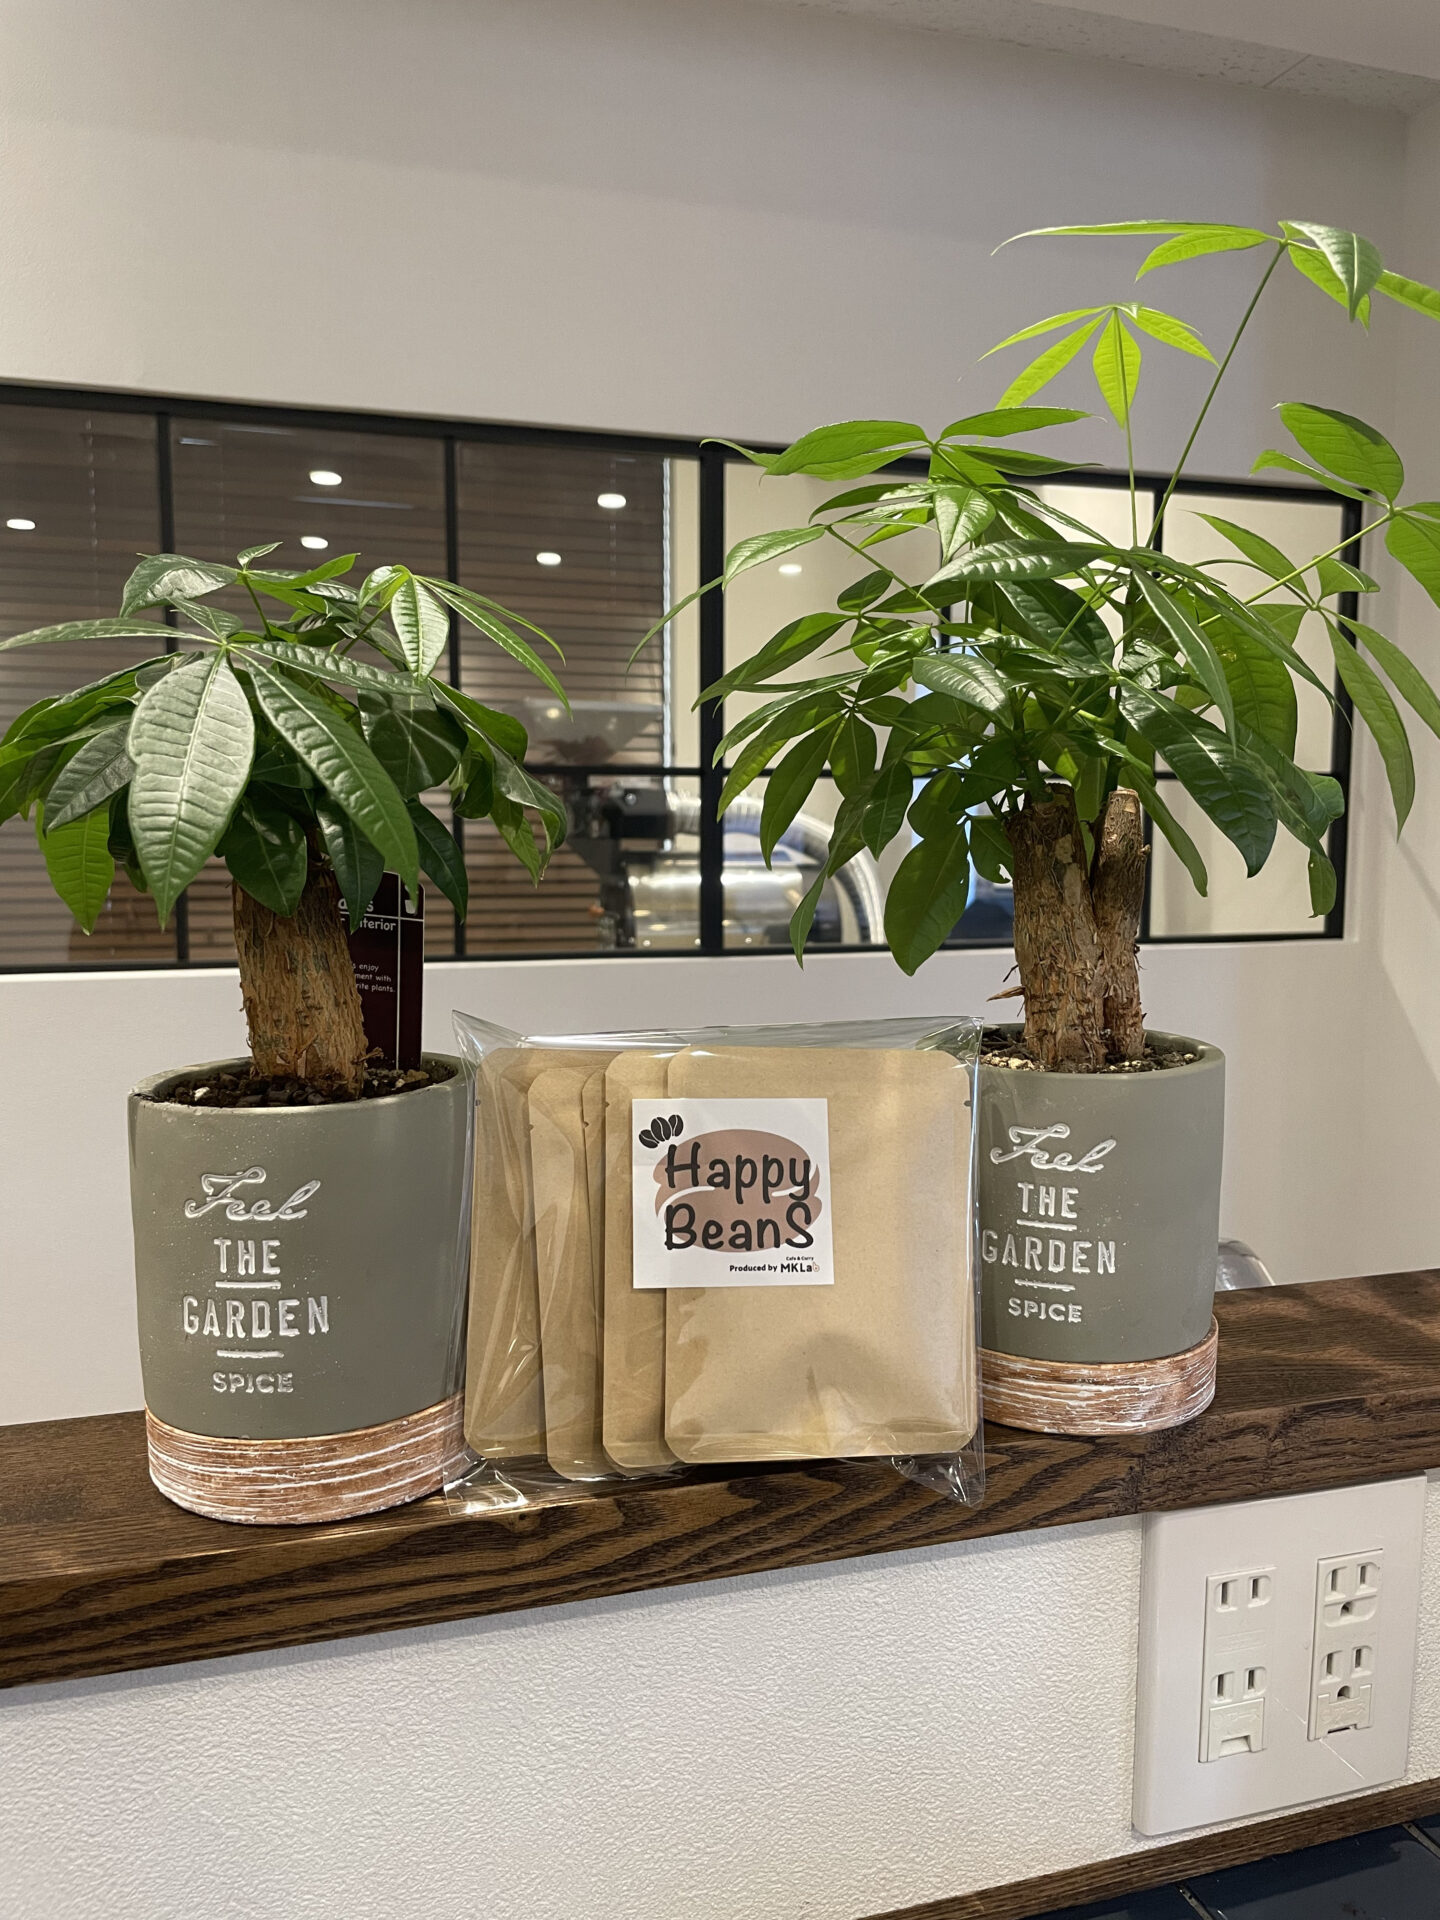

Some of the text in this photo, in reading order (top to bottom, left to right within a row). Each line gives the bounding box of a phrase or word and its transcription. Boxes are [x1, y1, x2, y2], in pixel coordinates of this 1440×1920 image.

[359, 963, 379, 972] enjoy
[371, 984, 396, 992] plants.
[990, 1123, 1117, 1173] Feel
[665, 1142, 811, 1204] Happy
[184, 1166, 321, 1221] Feel
[1017, 1182, 1079, 1218] THE
[213, 1238, 281, 1275] THE
[729, 1264, 766, 1272] Produced
[768, 1264, 778, 1272] by
[982, 1230, 1116, 1274] GARDEN
[182, 1295, 330, 1338] GARDEN
[1008, 1297, 1083, 1323] SPICE
[212, 1370, 294, 1394] SPICE
